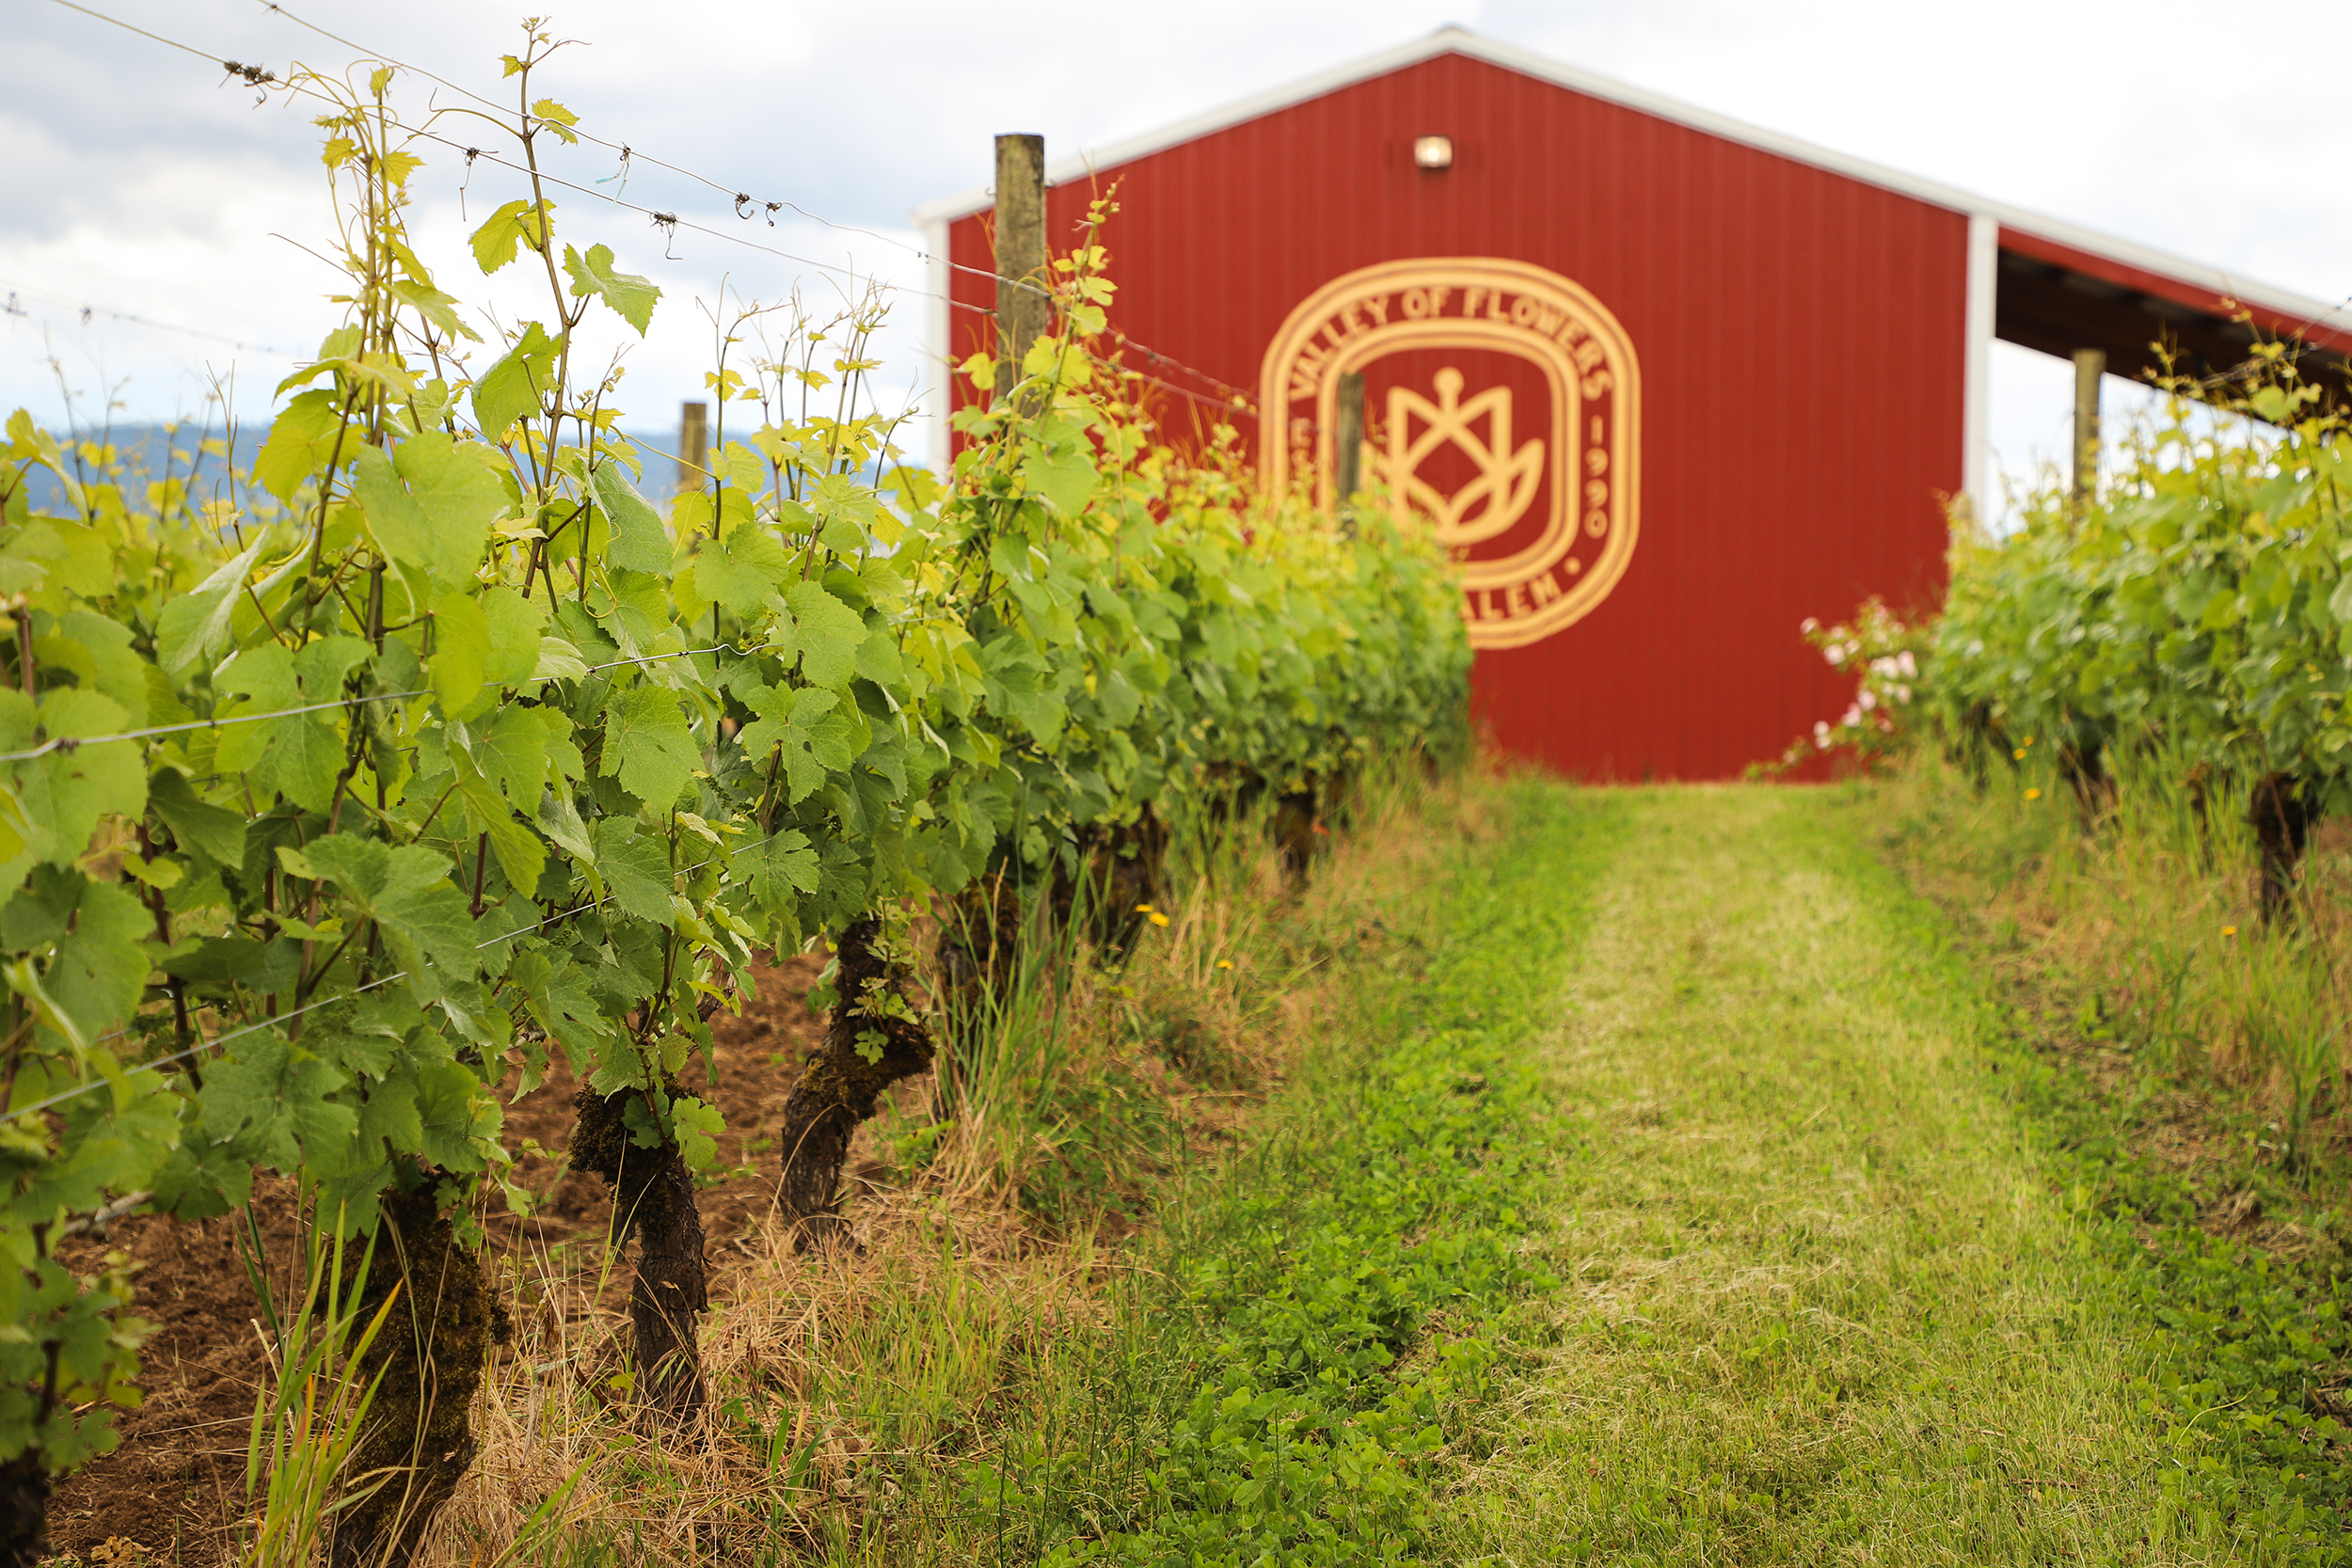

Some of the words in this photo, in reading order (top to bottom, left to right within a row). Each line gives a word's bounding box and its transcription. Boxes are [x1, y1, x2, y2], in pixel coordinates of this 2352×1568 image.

[1289, 293, 1389, 403] VALLEY
[1402, 286, 1452, 320] OF
[1463, 287, 1613, 401] FLOWERS
[1583, 415, 1609, 539] 1990
